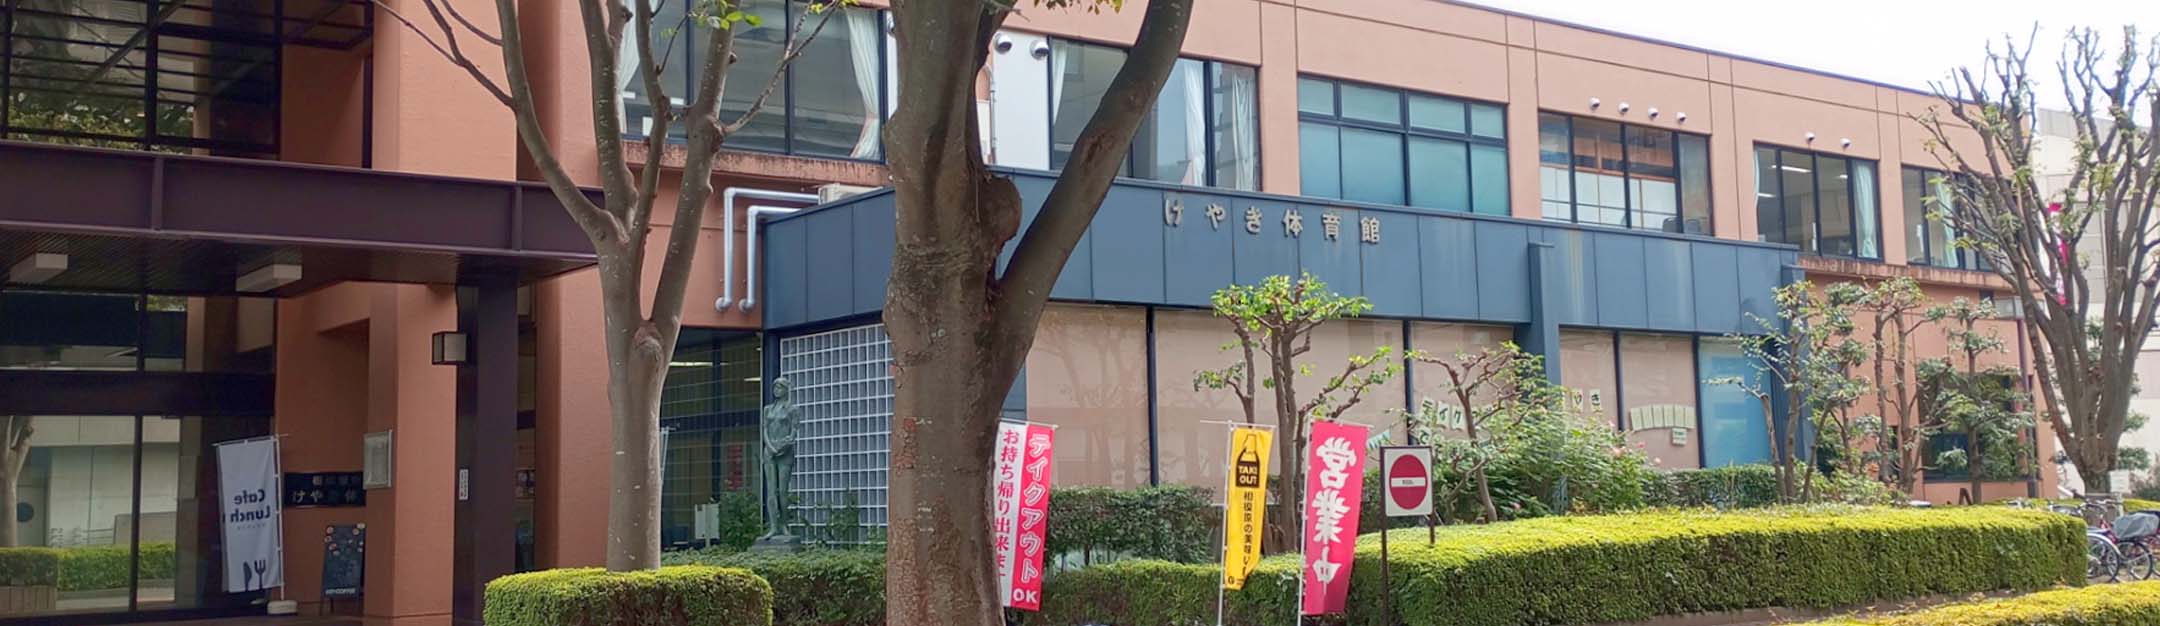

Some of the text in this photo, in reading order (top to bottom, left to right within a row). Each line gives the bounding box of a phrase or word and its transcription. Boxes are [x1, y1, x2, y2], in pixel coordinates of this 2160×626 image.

[1164, 198, 1380, 243] けやき体育館
[994, 429, 1020, 577] お持ち帰り出来ま
[1020, 434, 1050, 584] テイクアウト
[1239, 474, 1257, 485] OUT
[1311, 436, 1357, 596] 営業中
[1012, 588, 1038, 603] OK
